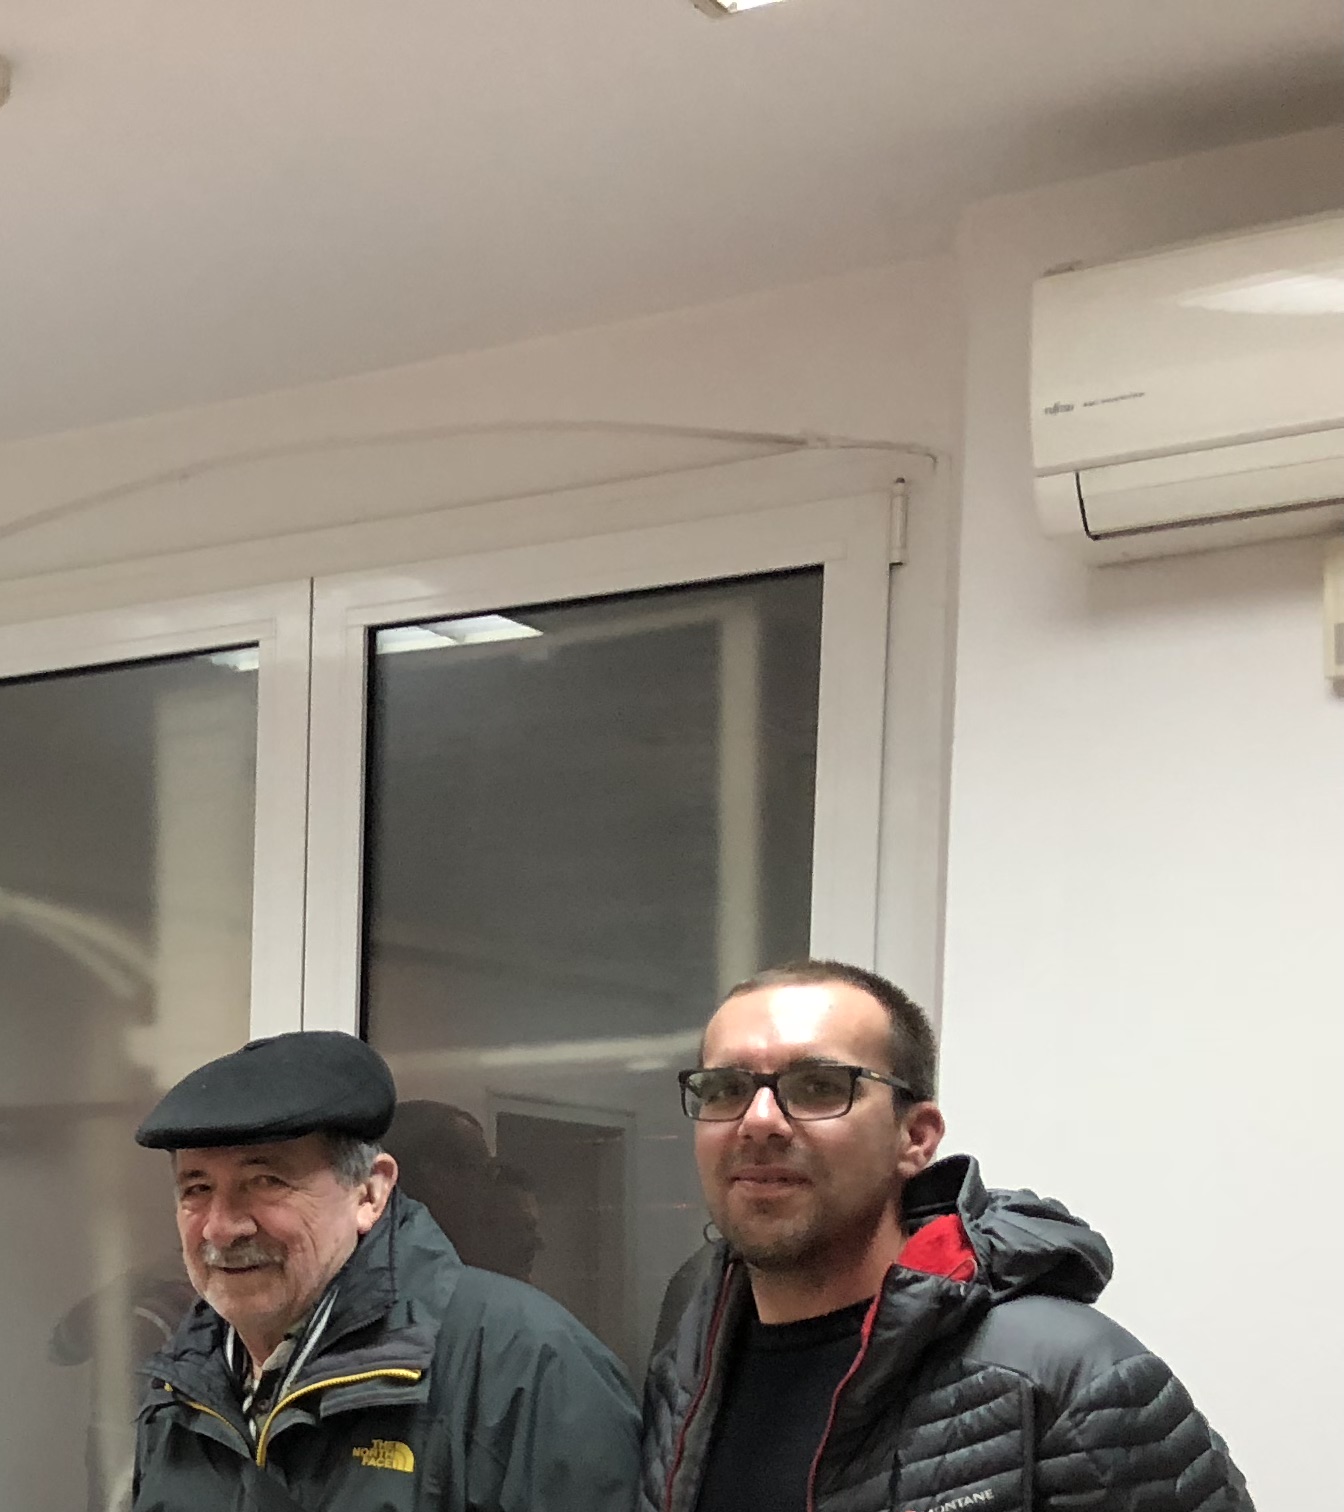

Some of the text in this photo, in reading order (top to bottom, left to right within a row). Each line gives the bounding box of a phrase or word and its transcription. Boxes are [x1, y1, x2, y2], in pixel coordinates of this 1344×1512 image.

[372, 1439, 393, 1450] THE
[352, 1447, 393, 1460] NORTH
[361, 1456, 393, 1469] FACE
